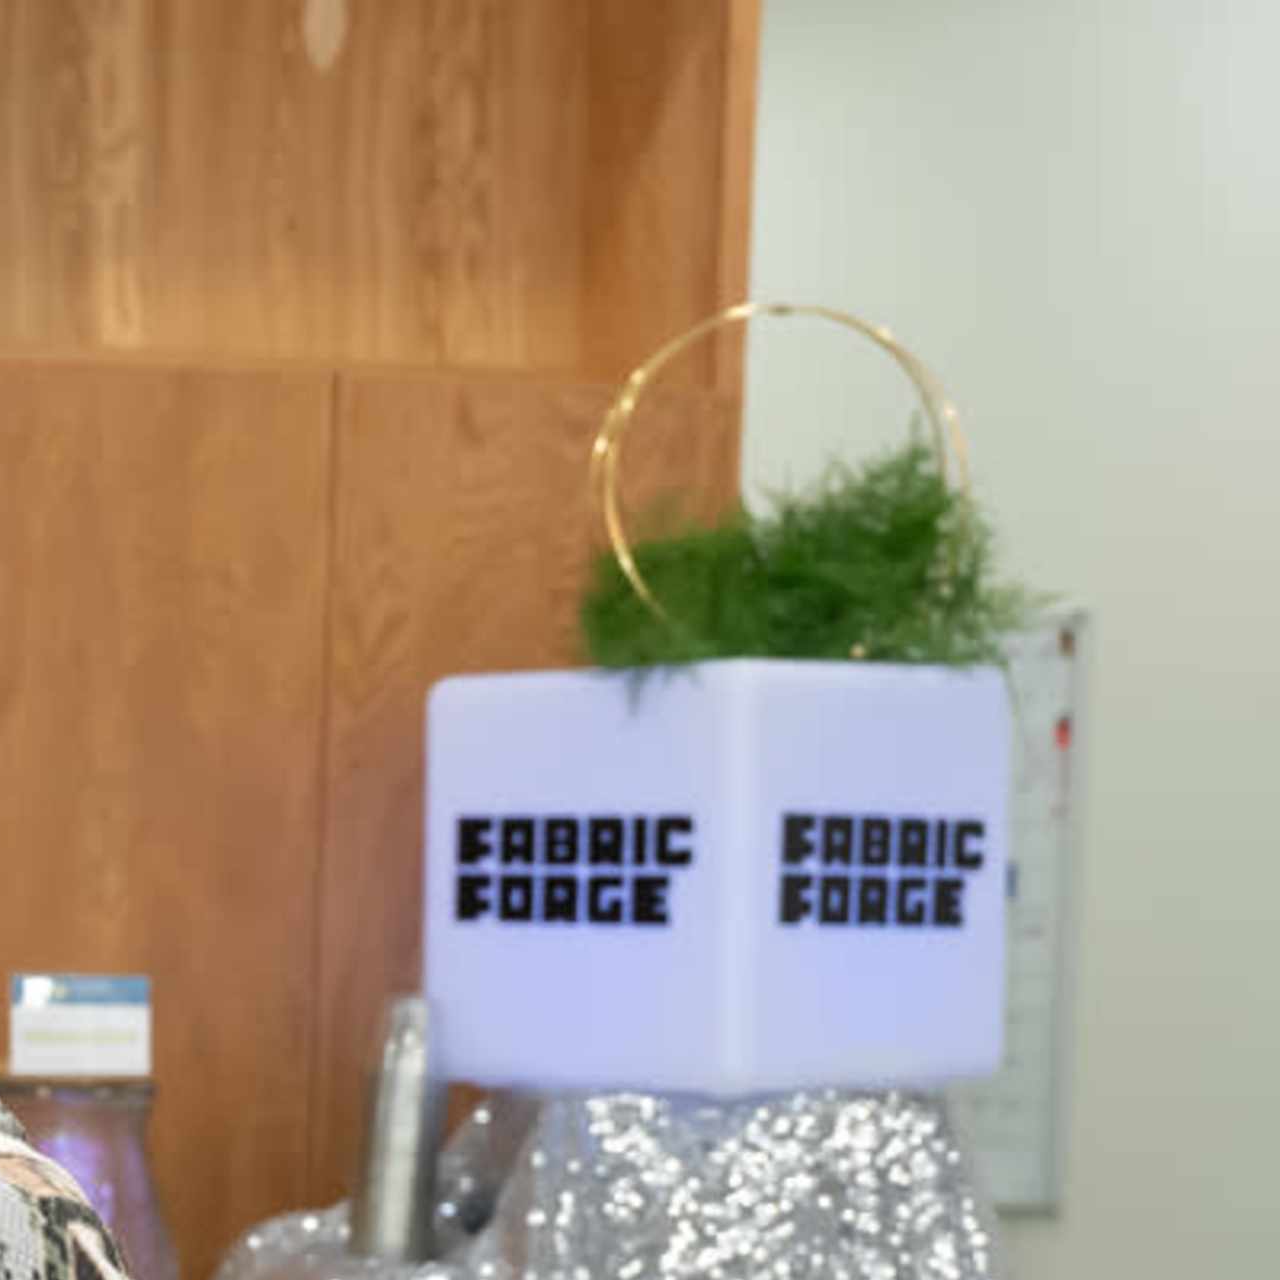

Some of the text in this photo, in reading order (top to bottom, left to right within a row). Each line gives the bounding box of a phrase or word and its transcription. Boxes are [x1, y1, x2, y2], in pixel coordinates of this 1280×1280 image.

[456, 815, 693, 867] FABRIC
[781, 813, 986, 869] FABRIC
[455, 874, 670, 924] FORGE
[779, 874, 965, 926] FORGE
